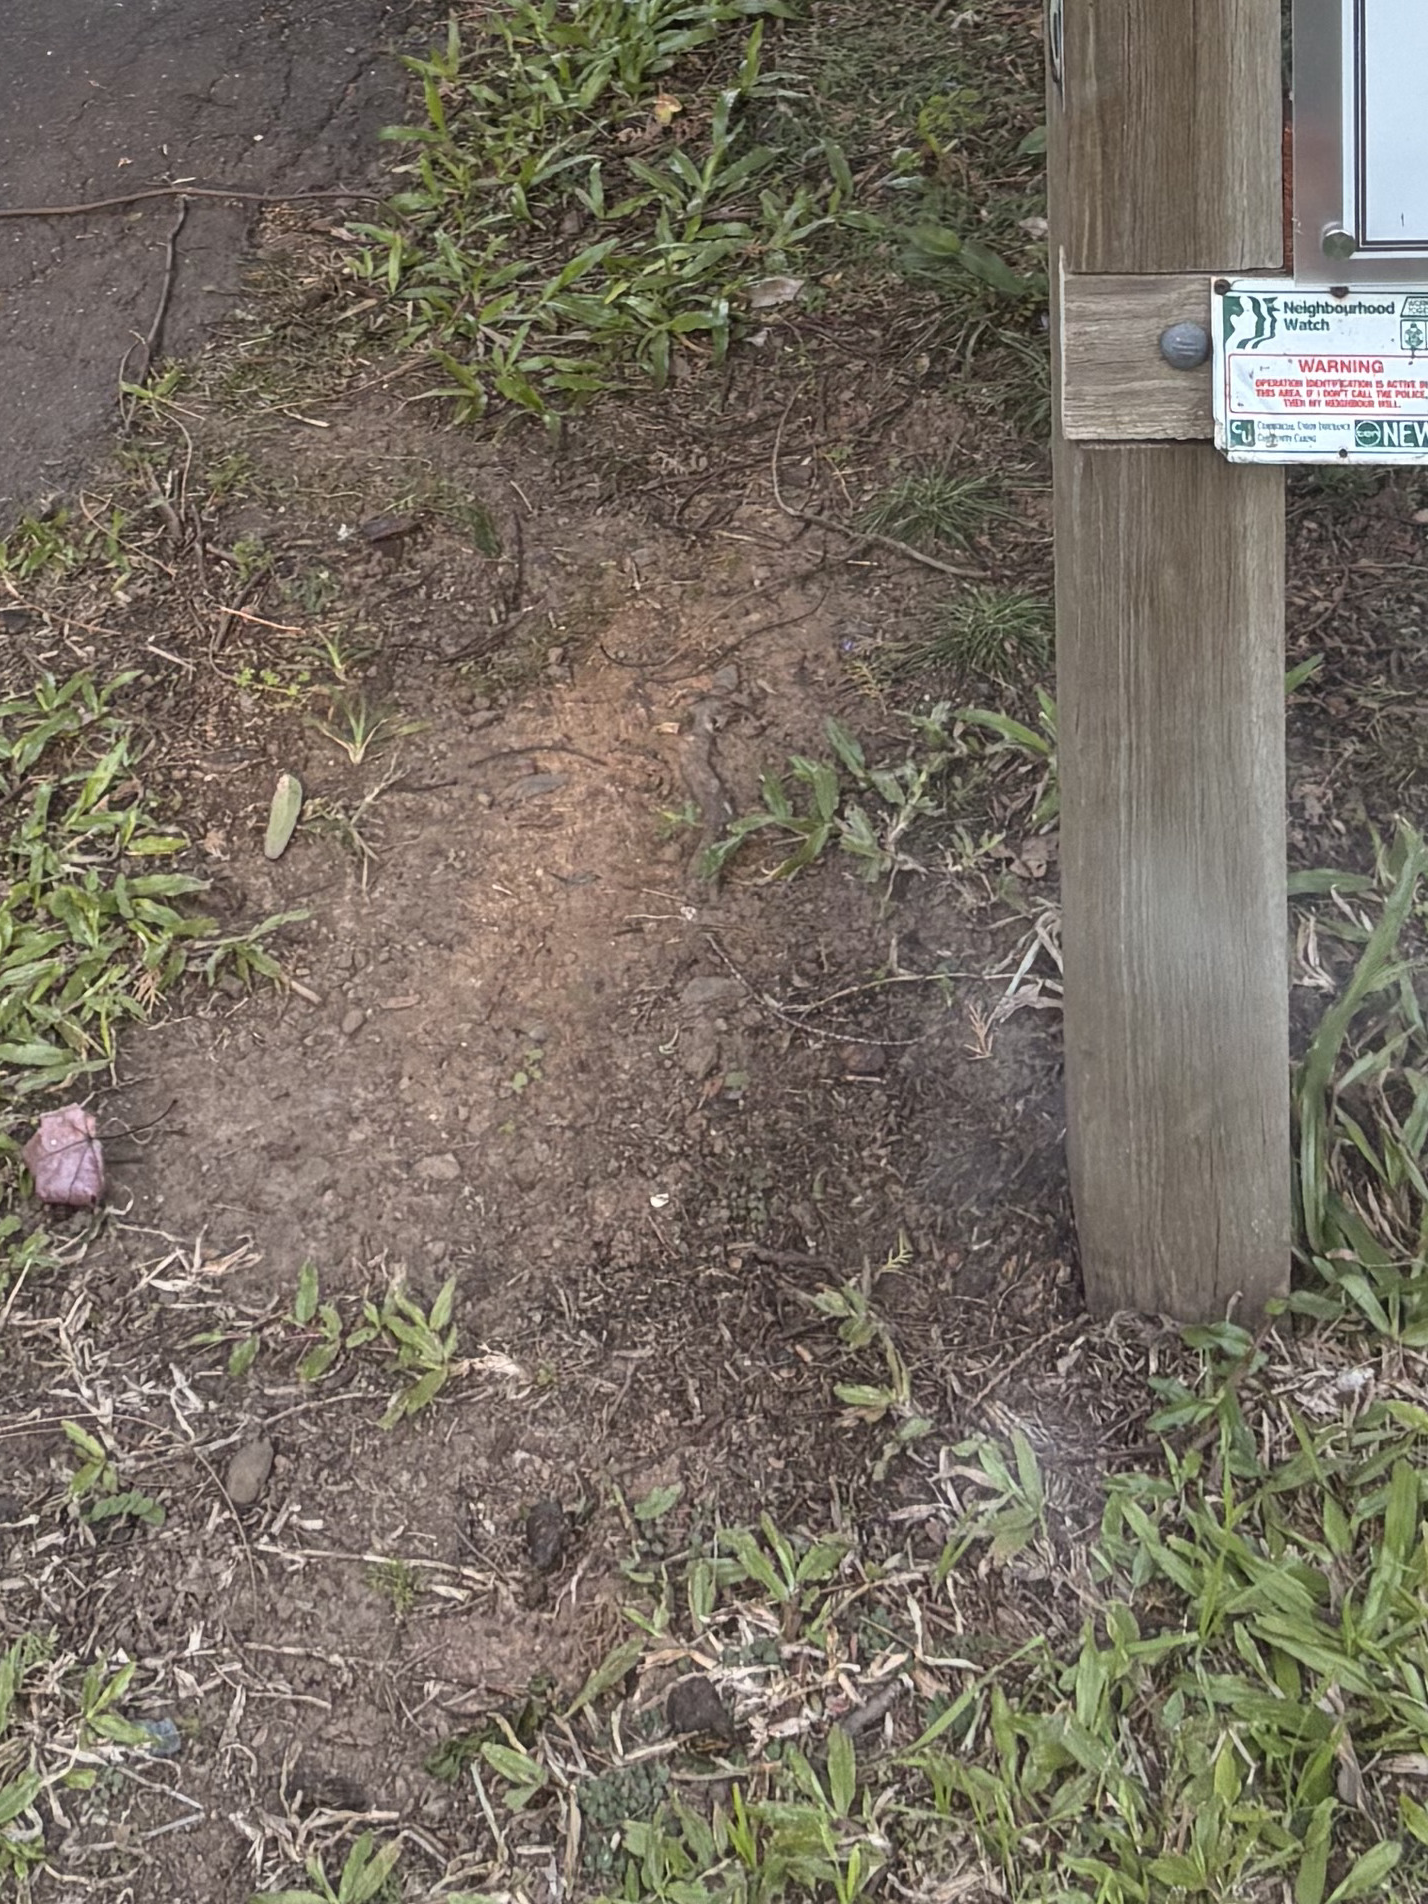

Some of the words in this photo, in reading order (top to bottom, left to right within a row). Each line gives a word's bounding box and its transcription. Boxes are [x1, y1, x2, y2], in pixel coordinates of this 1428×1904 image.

[1283, 301, 1395, 318] Neighbourhood
[1283, 318, 1330, 331] Watch
[1298, 359, 1384, 374] WARNING
[1255, 379, 1303, 387] OPERATION
[1351, 390, 1372, 398] CALL
